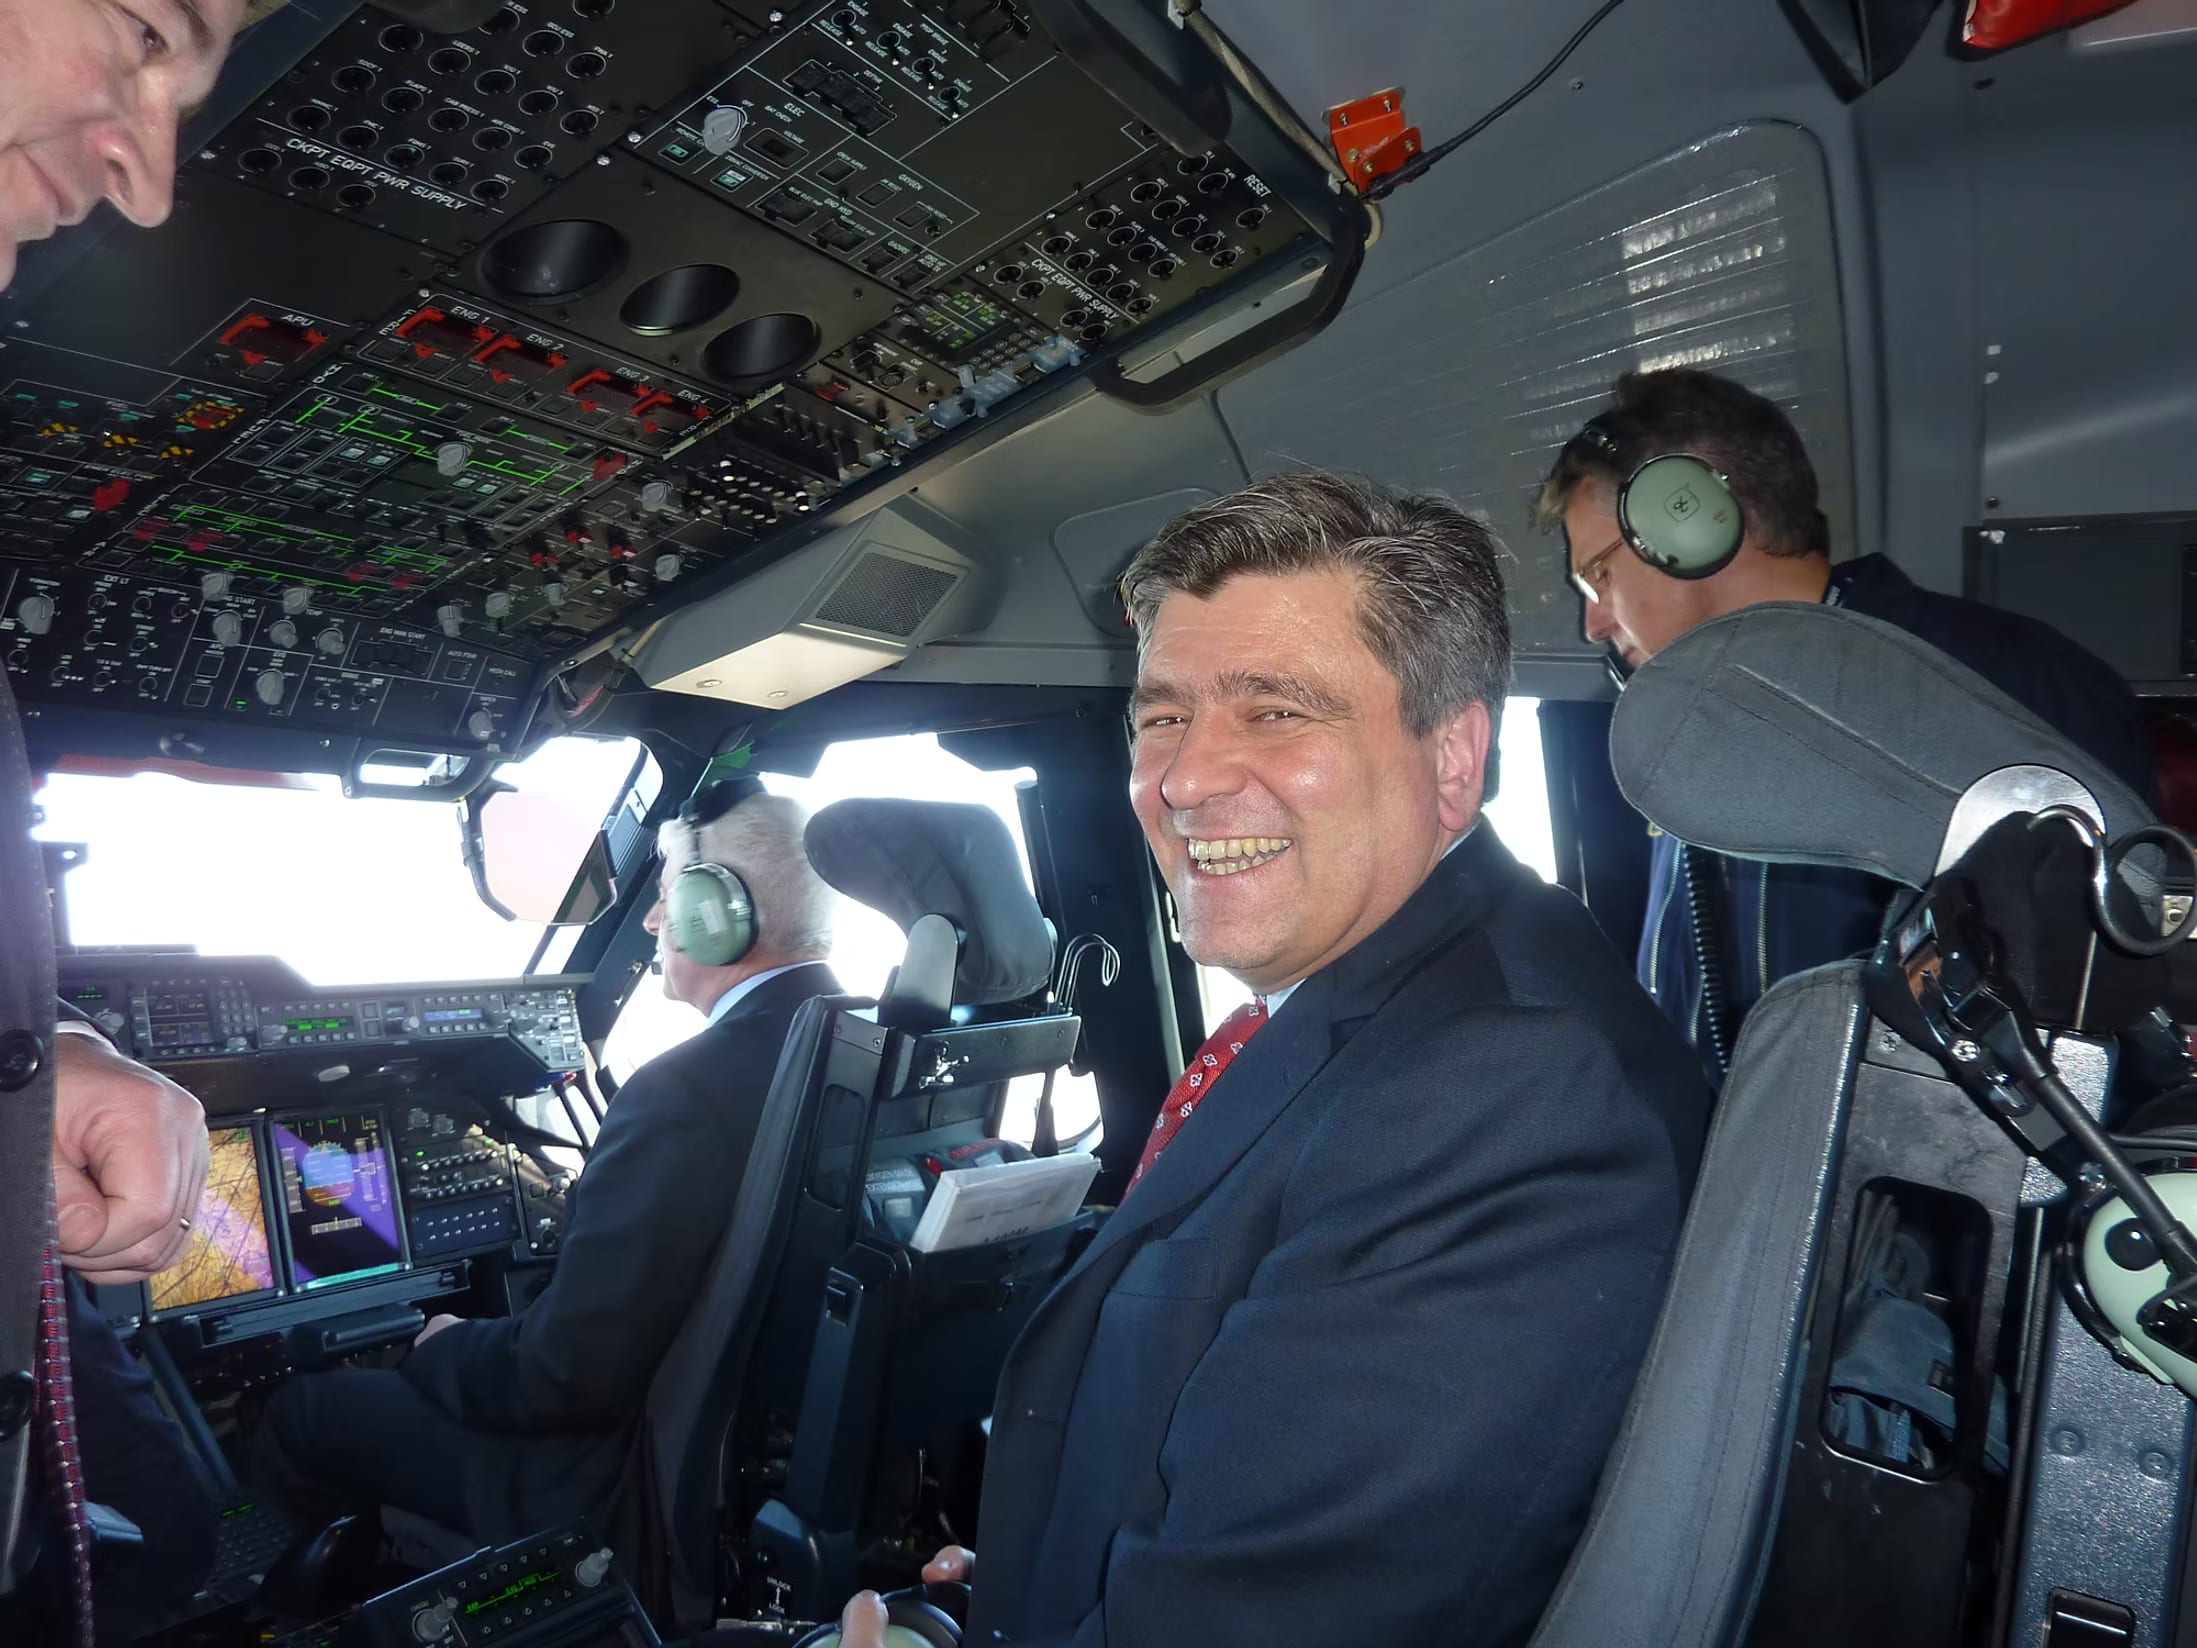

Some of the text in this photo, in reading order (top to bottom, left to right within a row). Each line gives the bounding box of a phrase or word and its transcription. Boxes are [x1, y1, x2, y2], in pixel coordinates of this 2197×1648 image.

[783, 102, 806, 118] ELEC
[286, 138, 331, 159] CKPT
[330, 155, 374, 175] EQPT
[373, 171, 411, 191] PWR
[410, 185, 467, 212] SUPPLY
[898, 173, 924, 191] OXYGEN
[1243, 173, 1273, 198] RESET
[1031, 258, 1121, 320] CKPT EQPT PWR SUPPLY
[450, 305, 481, 320] ENG
[280, 313, 316, 328] APU
[526, 333, 553, 347] ENG
[615, 366, 641, 379] ENG
[677, 389, 701, 401] ENG
[104, 574, 119, 583] EXT
